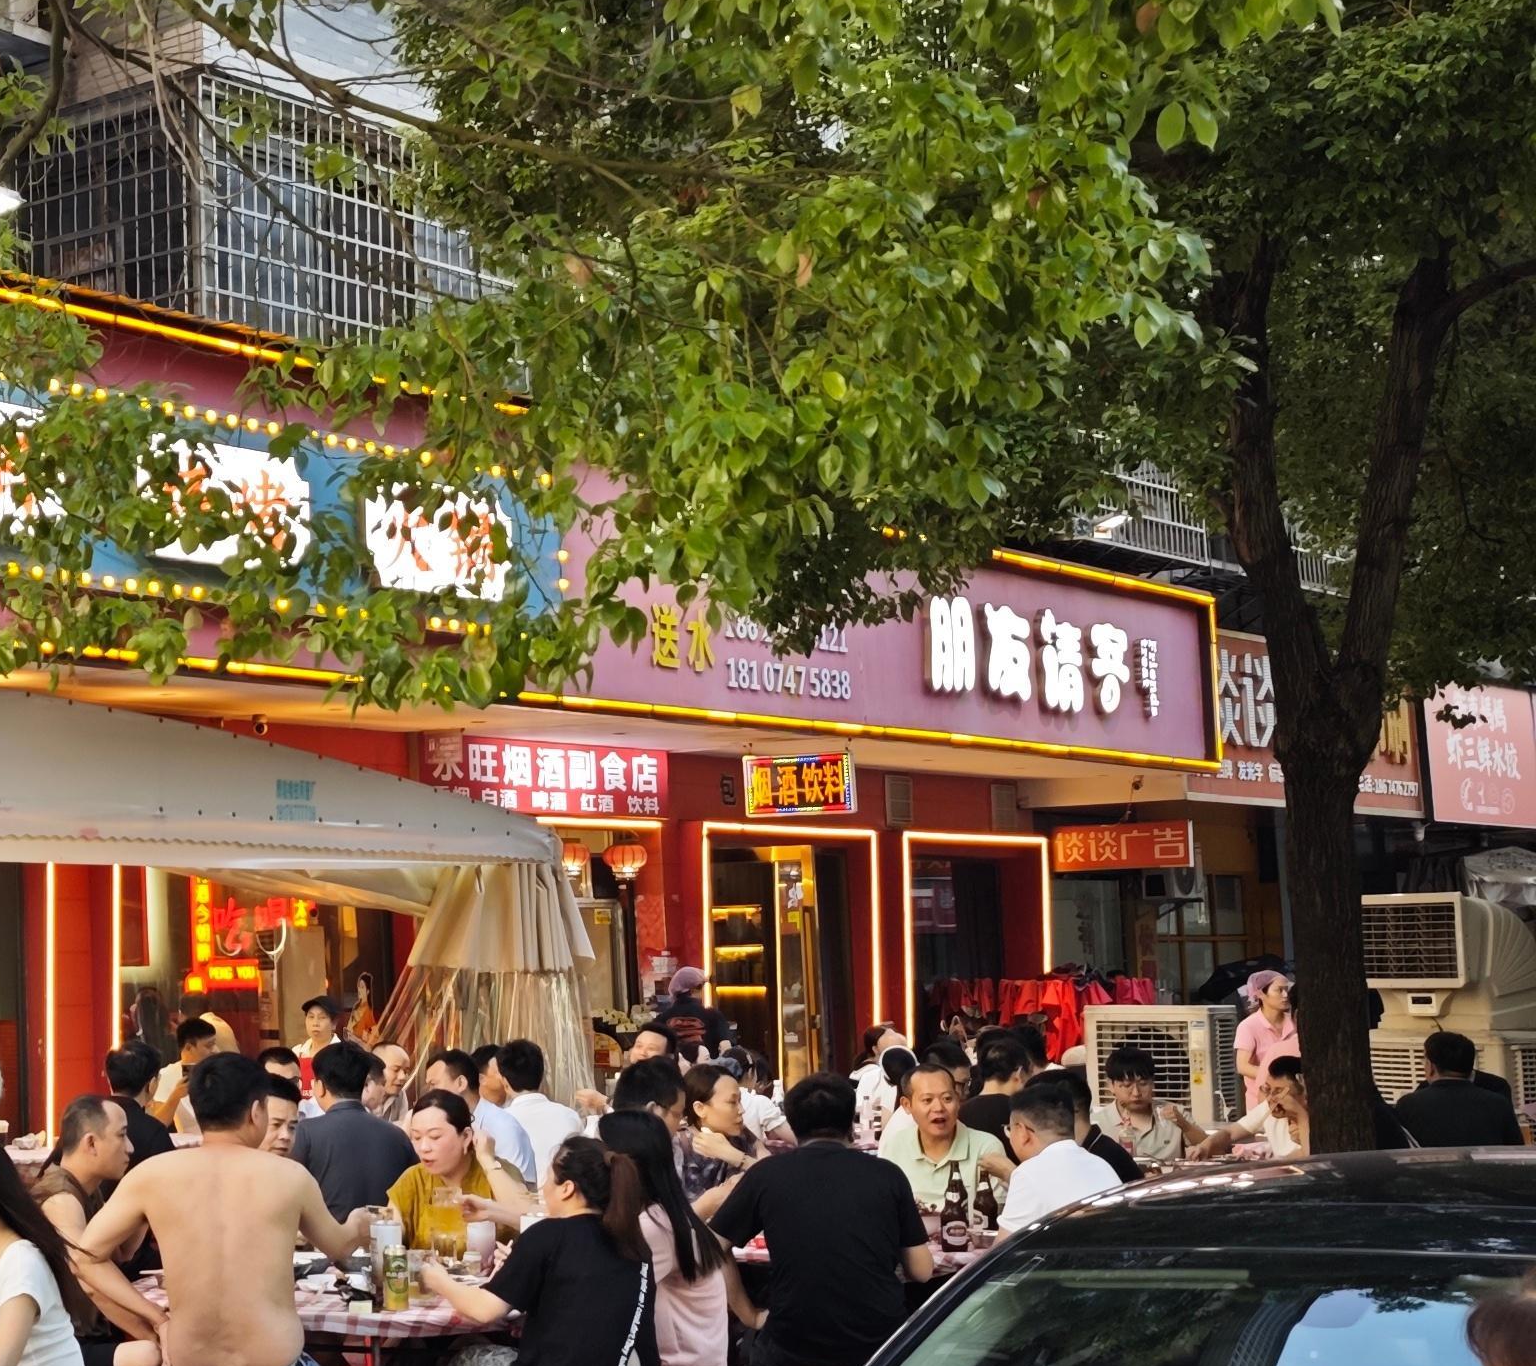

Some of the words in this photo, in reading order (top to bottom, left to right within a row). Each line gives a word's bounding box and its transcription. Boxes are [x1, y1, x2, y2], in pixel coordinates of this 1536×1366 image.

[652, 603, 714, 672] 送水
[930, 595, 1130, 713] 朋友请客
[481, 787, 518, 810] 白酒
[580, 792, 615, 813] 红酒
[627, 795, 660, 815] 饮料
[752, 761, 844, 806] 烟酒饮料
[1054, 828, 1184, 863] 谈谈广告
